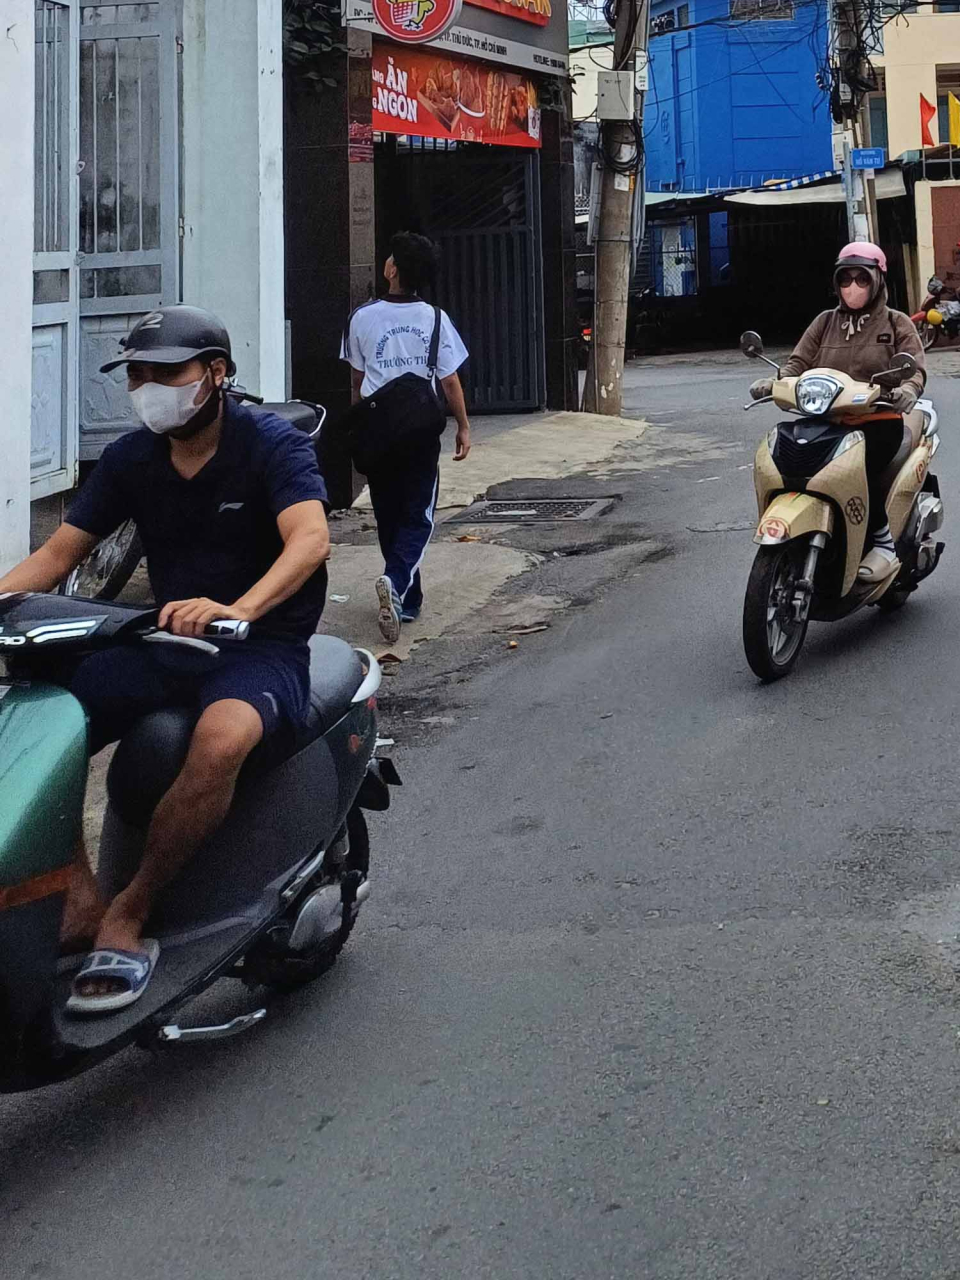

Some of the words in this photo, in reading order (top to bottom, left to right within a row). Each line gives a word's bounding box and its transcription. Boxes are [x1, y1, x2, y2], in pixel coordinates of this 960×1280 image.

[377, 87, 417, 123] NGON
[387, 325, 410, 337] TRUNG
[414, 355, 427, 365] TH
